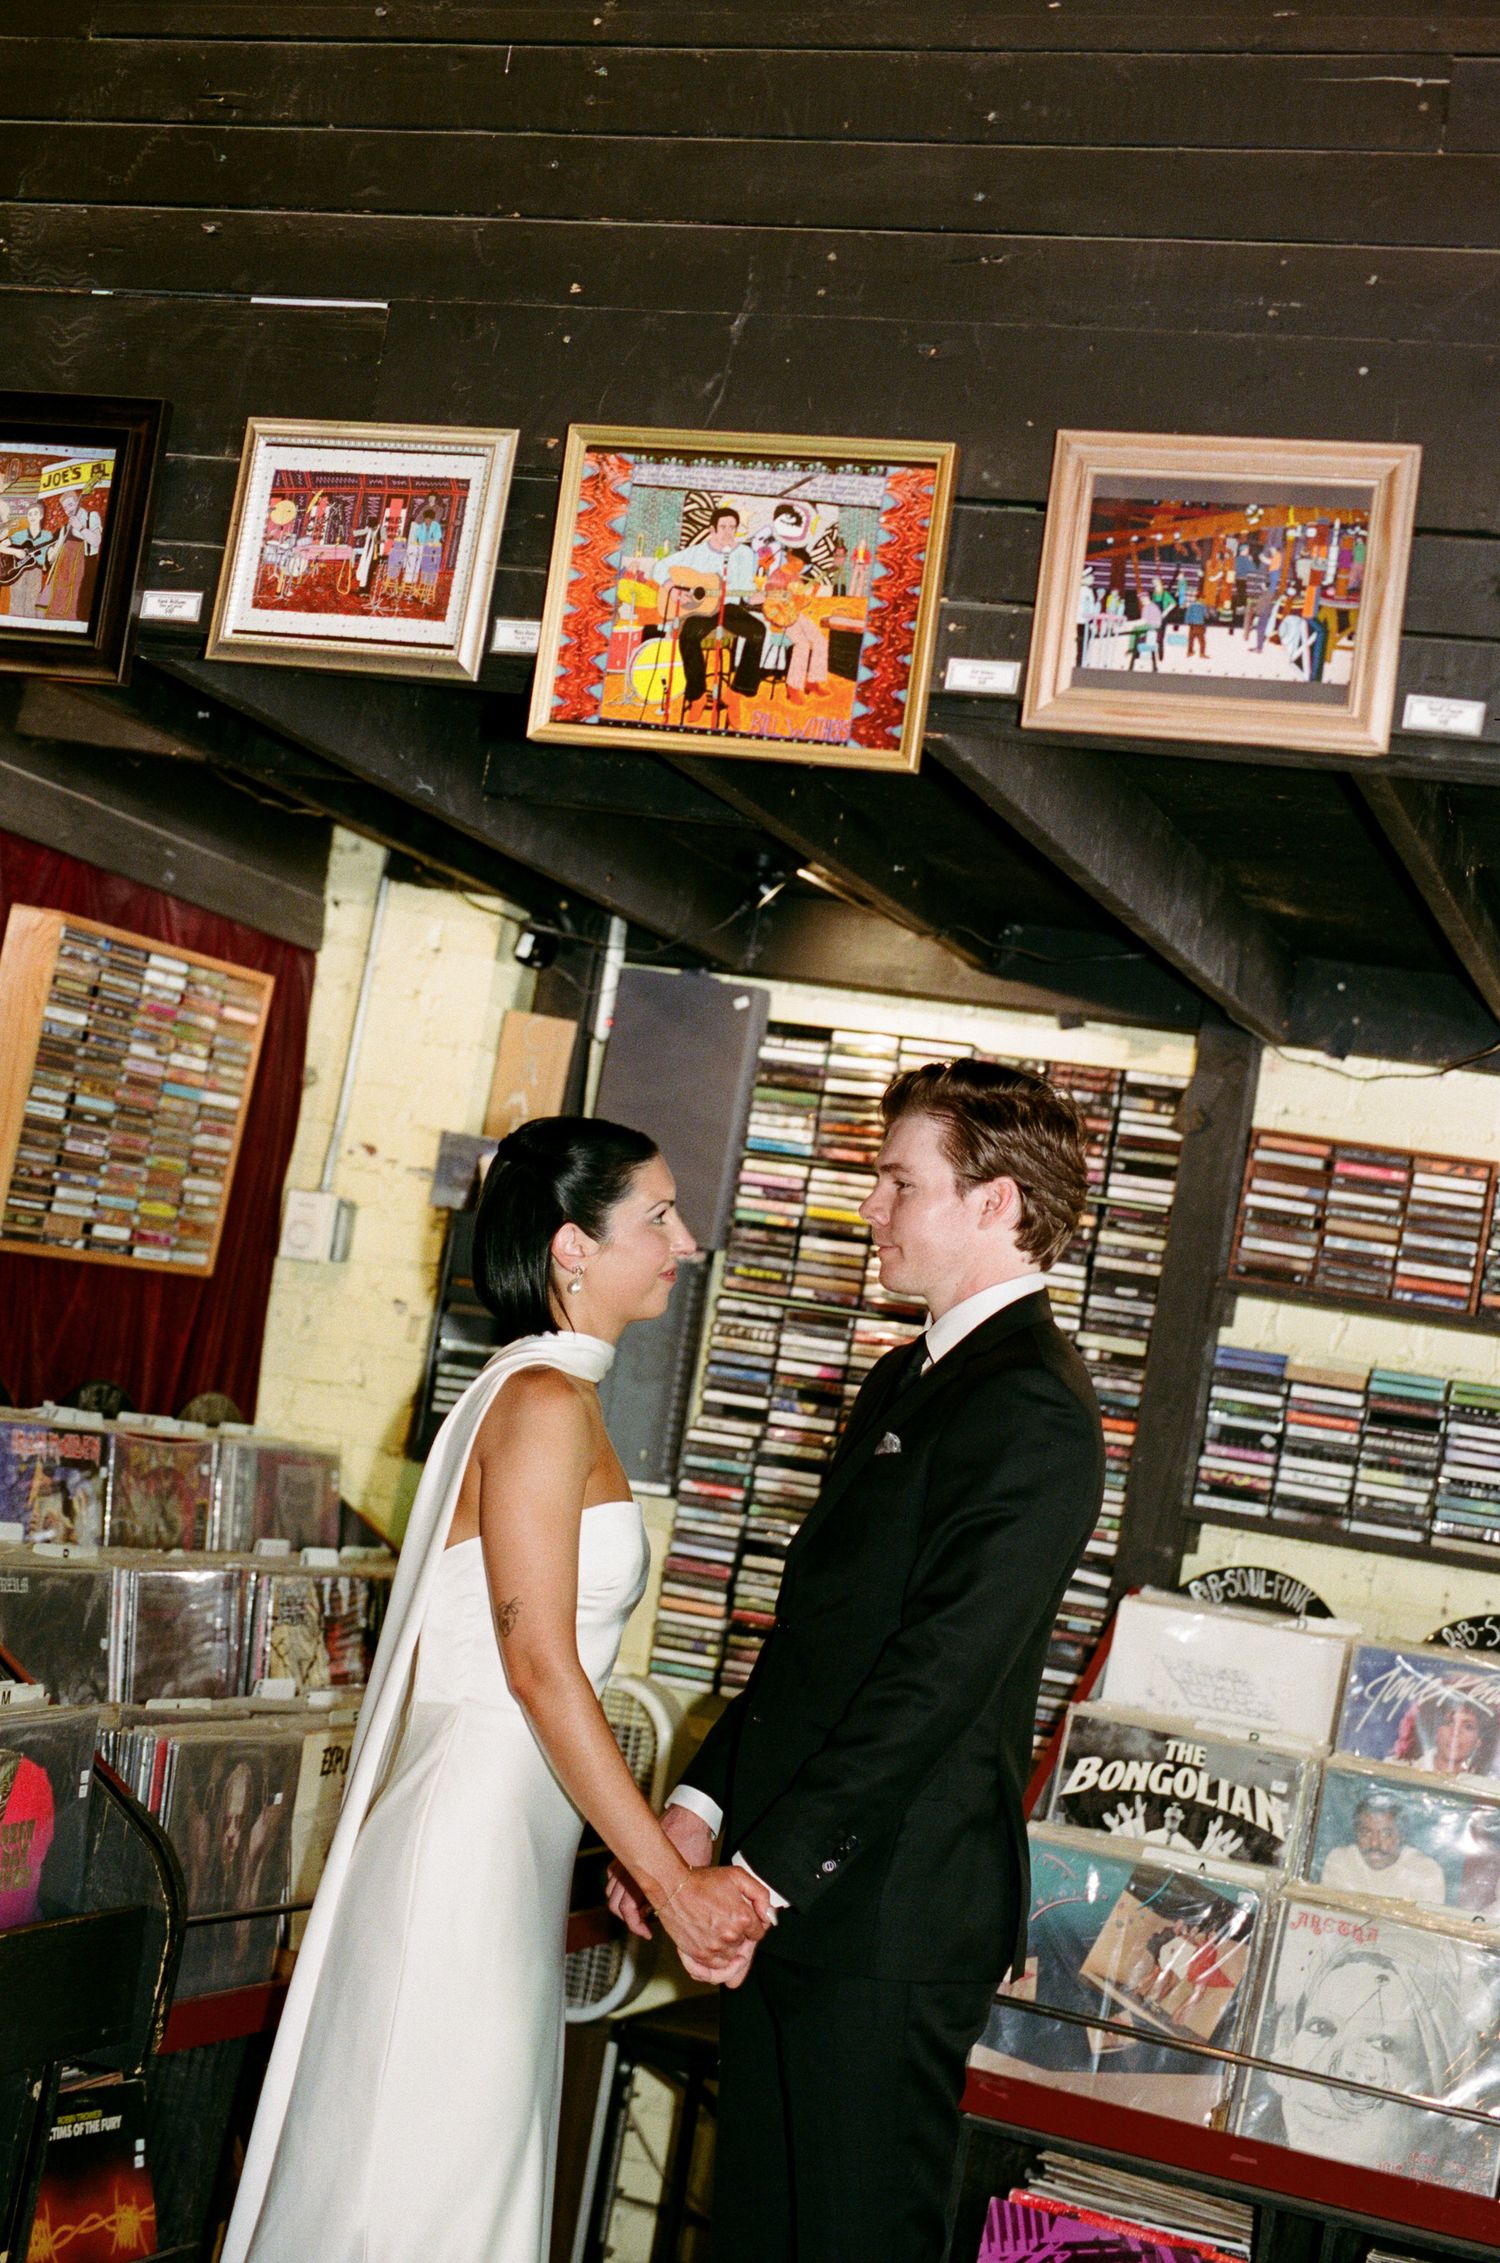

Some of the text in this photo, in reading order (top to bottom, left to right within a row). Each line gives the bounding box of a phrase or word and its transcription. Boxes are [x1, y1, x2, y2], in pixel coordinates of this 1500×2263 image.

[43, 466, 82, 489] JOE'S
[1165, 1739, 1207, 1767] THE
[1059, 1755, 1287, 1843] BONGOLIAN
[1289, 1911, 1379, 1945] ARETHA
[73, 2123, 85, 2136] OF
[86, 2120, 100, 2134] THE
[101, 2115, 122, 2131] FURY
